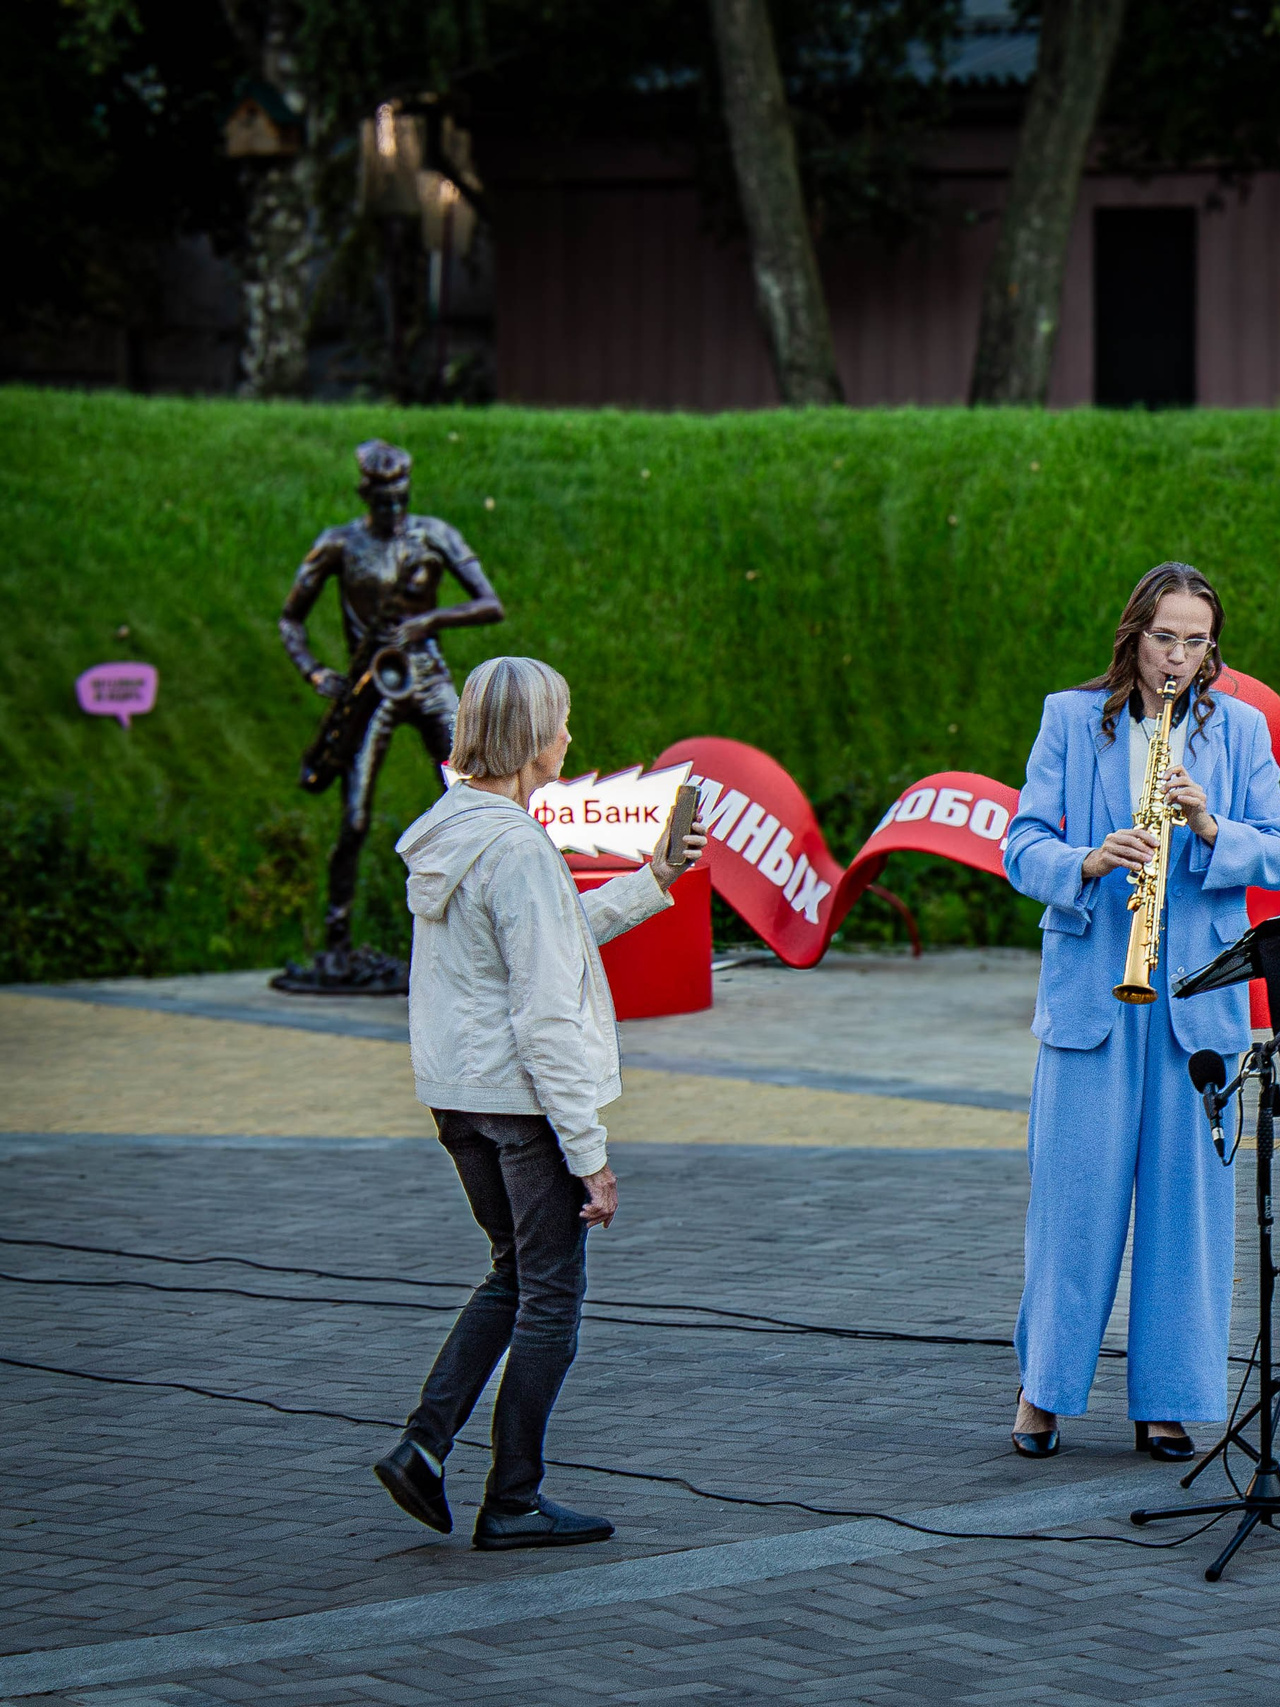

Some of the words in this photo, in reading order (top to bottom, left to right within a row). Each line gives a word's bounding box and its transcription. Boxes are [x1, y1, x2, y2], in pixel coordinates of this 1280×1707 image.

[534, 800, 575, 828] фа
[583, 800, 661, 824] Банк
[684, 774, 832, 925] МНЫХ
